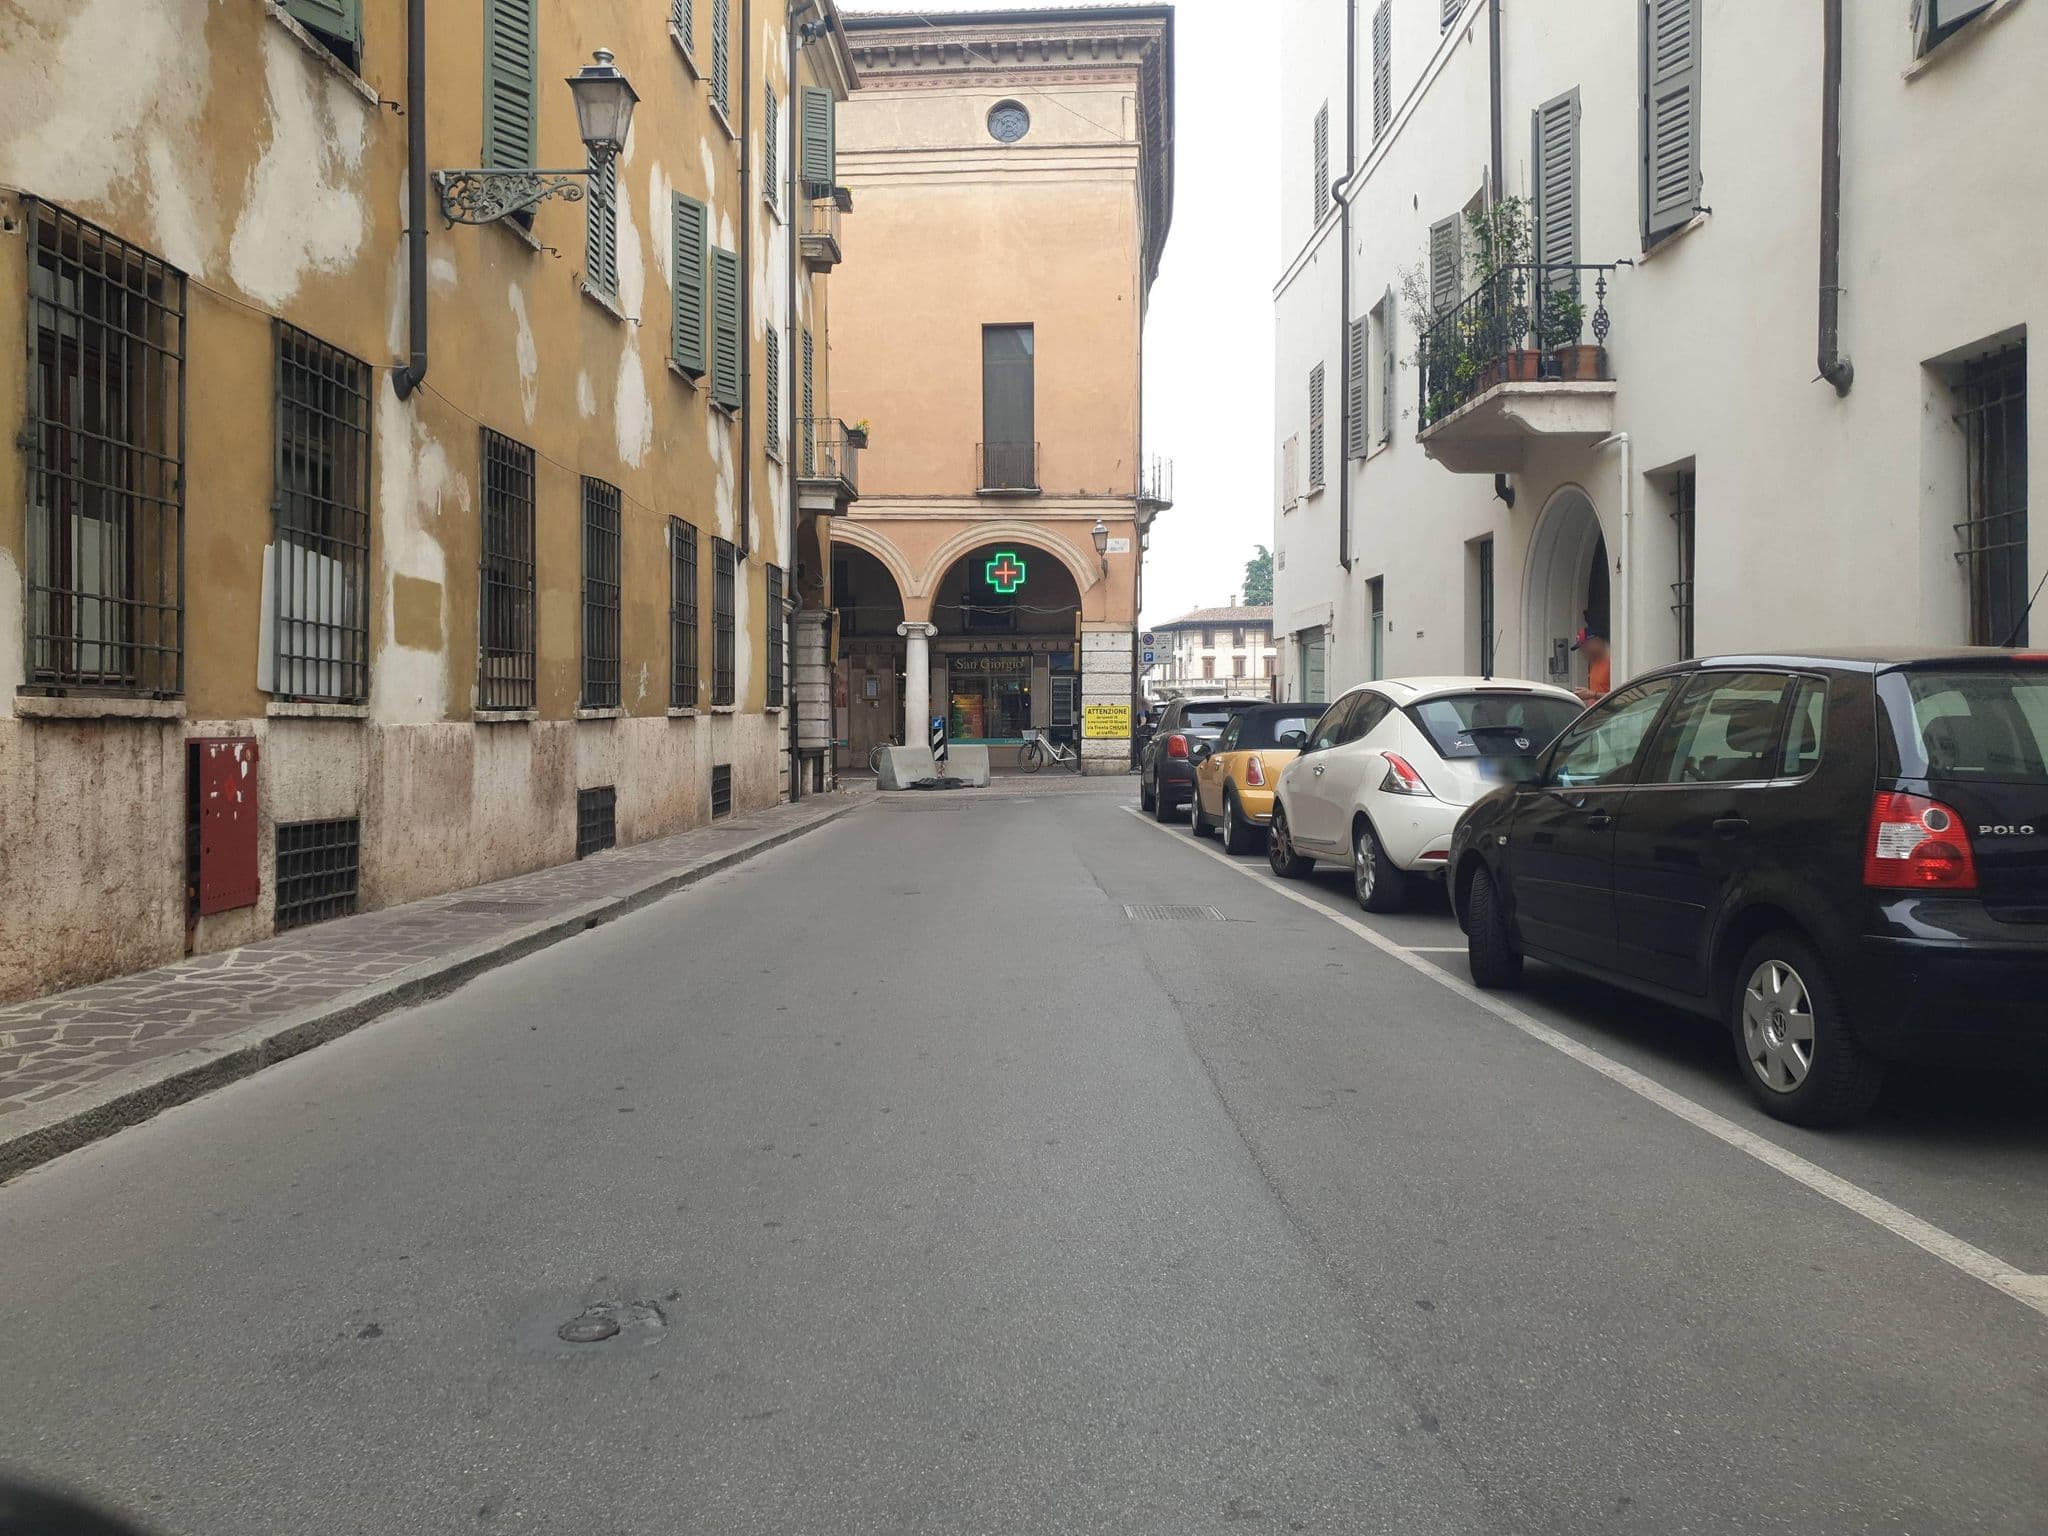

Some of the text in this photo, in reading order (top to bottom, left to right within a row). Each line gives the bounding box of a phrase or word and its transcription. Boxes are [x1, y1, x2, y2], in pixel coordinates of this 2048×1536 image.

[968, 640, 1075, 652] FARMACIA
[956, 658, 1023, 672] San Giorgio
[1979, 825, 2035, 835] POLO
